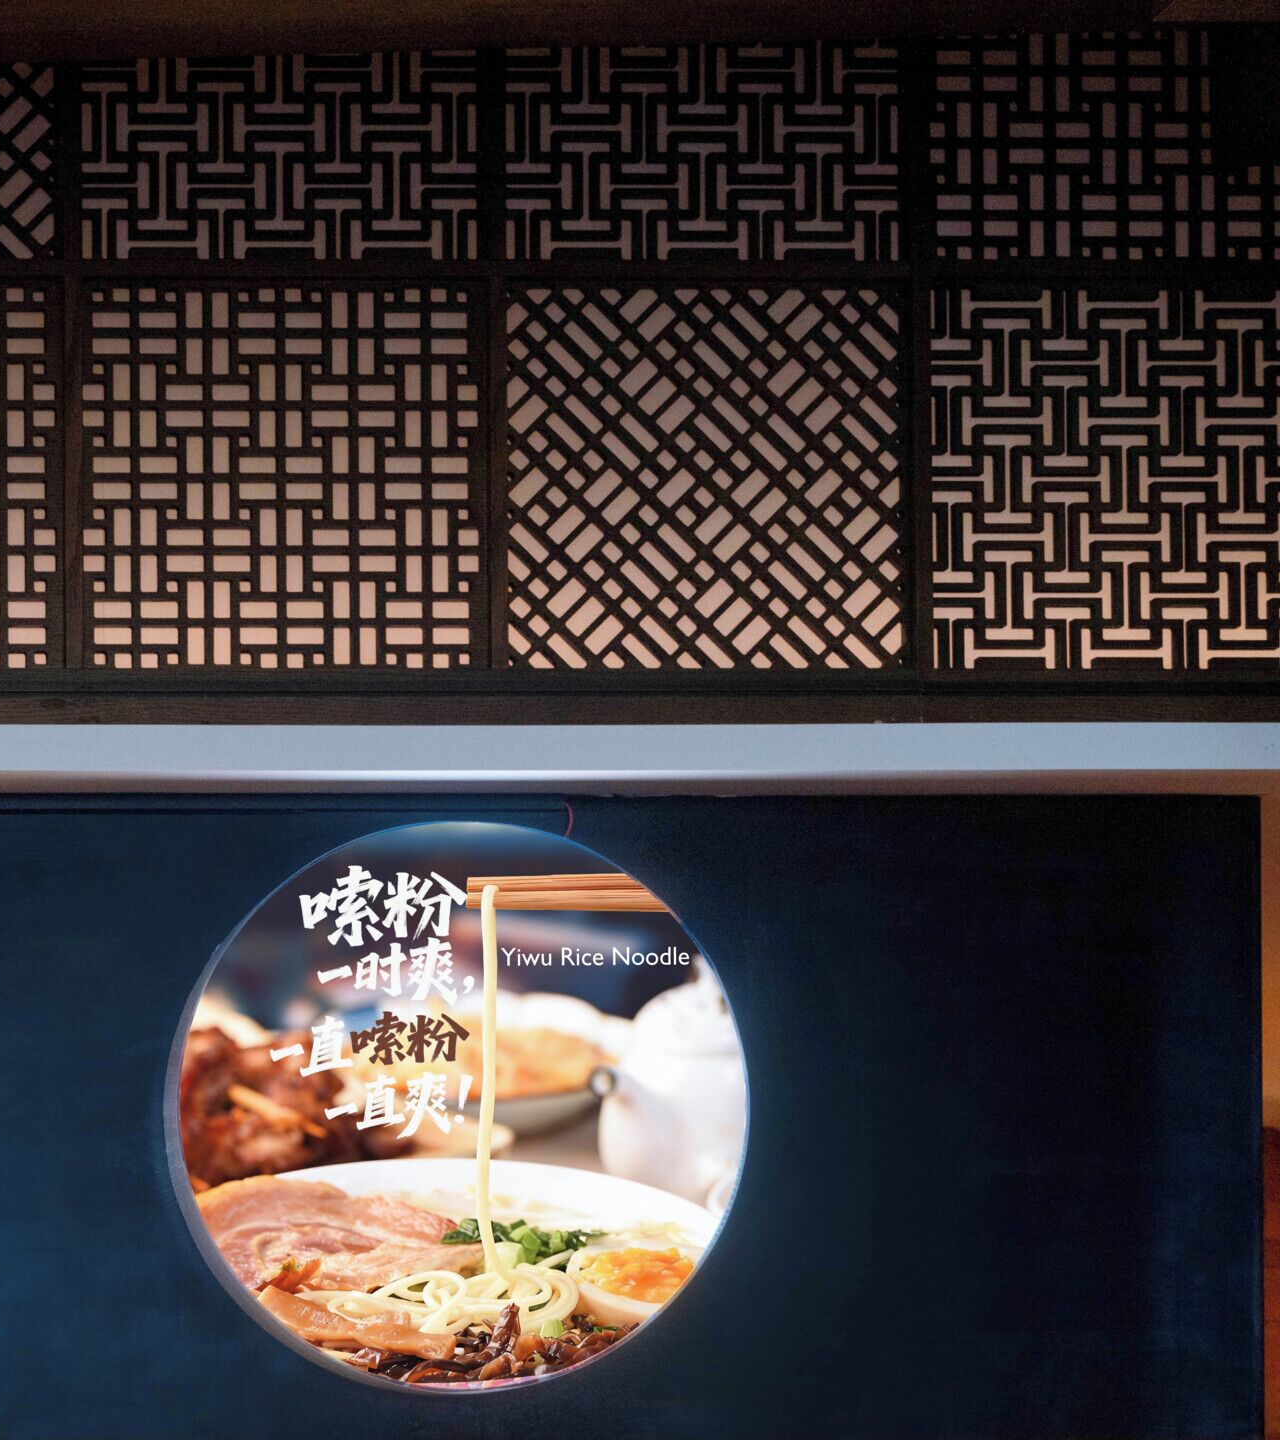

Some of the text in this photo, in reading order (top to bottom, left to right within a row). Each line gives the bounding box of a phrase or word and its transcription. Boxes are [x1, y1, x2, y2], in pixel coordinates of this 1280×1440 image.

[299, 864, 468, 948] 嗦粉
[500, 944, 691, 968] Yiwu Rice Noodle
[269, 1010, 470, 1079] 一直嗦粉
